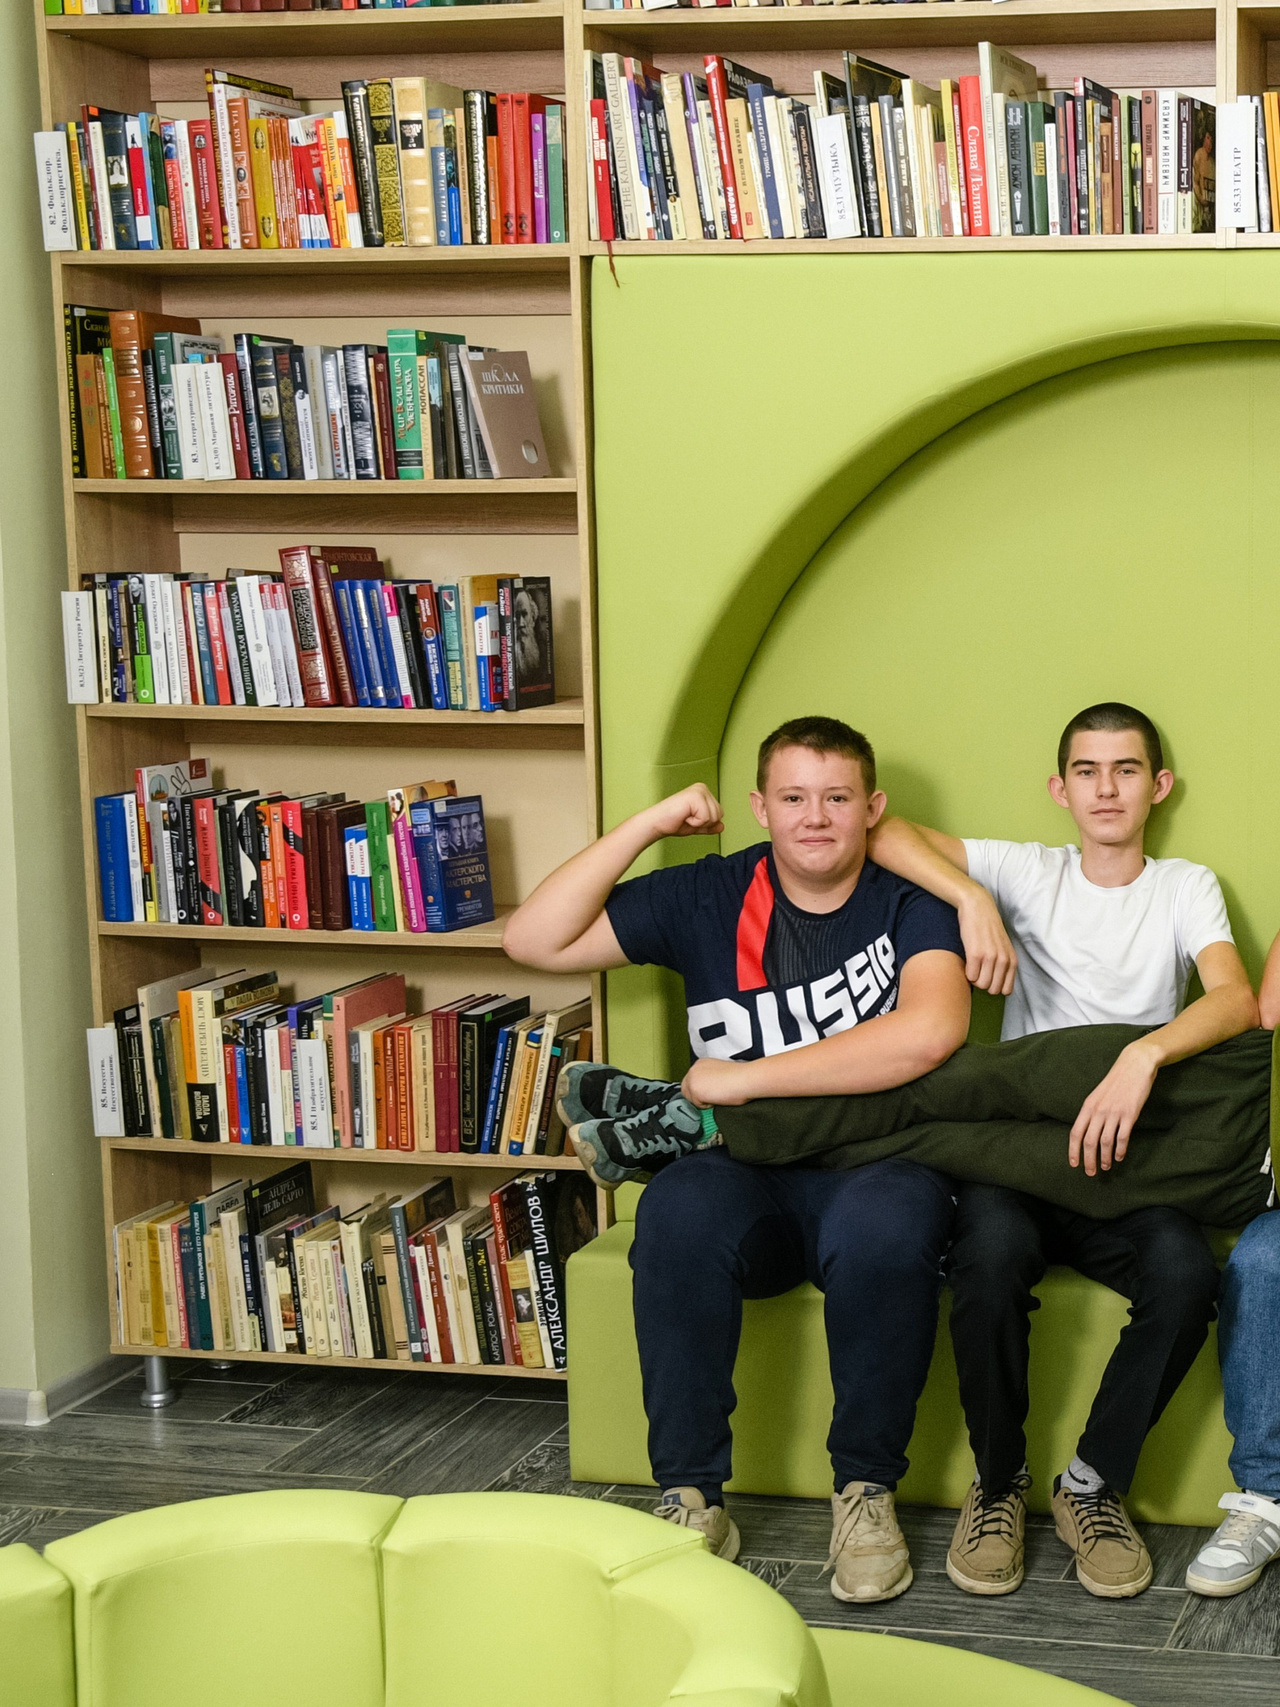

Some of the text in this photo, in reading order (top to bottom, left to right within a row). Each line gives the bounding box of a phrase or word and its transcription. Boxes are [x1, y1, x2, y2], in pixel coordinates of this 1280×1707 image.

[606, 58, 632, 209] THE KALININ ART GALLERY
[967, 126, 981, 169] Слава
[1010, 129, 1021, 162] ЛЕННОН
[44, 158, 55, 209] Фольклор.
[55, 149, 68, 233] Фольклористика.
[726, 187, 738, 225] РАФАЭЛЬ
[830, 142, 846, 220] 85.31 МУЗЫКА
[1233, 147, 1241, 213] 85.33 ТЕАТР
[418, 365, 427, 414] МОПАССАН
[190, 451, 199, 463] 83.
[231, 592, 253, 695] ЛЕНИНГРАДСКАЯ ПАНОРАМА
[397, 821, 418, 927] Самая полная книга свадебных тостов
[687, 932, 896, 1062] RUSSIA
[100, 1096, 108, 1108] 85.
[194, 1091, 203, 1119] ВОЛКОВА
[202, 1095, 210, 1116] ПАОЛА
[310, 1113, 318, 1130] 85.1
[492, 1203, 507, 1265] Атлас чудес света
[527, 1196, 566, 1350] АЛЕКСАНДР ШИЛОВ
[485, 1301, 501, 1361] КАРЛОС РОХАС
